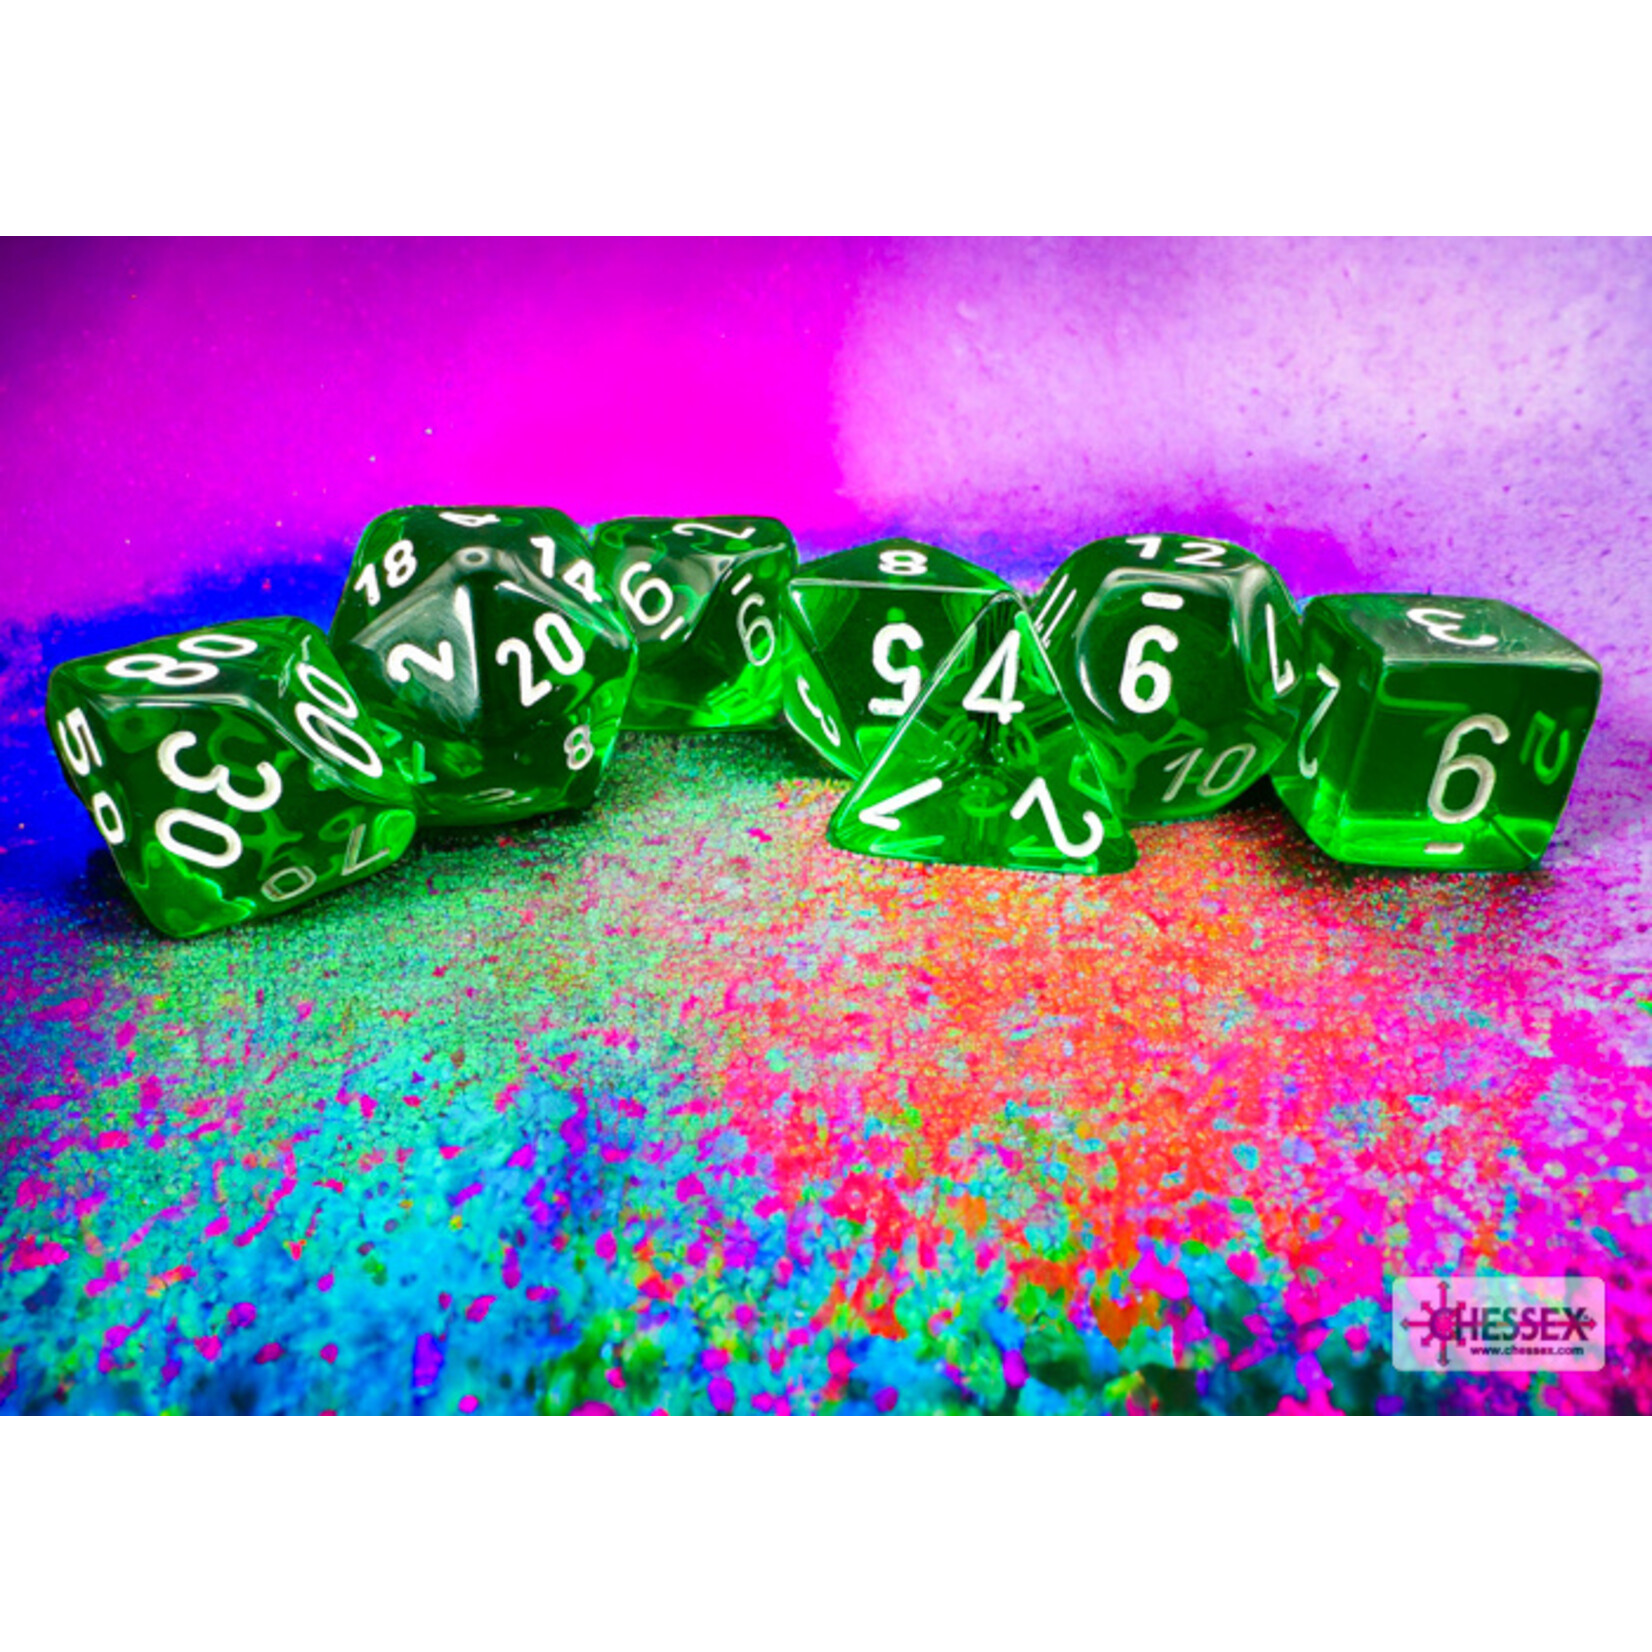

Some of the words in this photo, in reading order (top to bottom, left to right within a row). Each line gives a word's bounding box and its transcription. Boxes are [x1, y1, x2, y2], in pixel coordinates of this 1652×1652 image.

[354, 539, 417, 606] 18
[530, 535, 602, 604] 14
[878, 549, 928, 576] 8
[1125, 536, 1227, 567] 12
[105, 634, 258, 686] 80
[387, 640, 454, 682] 2
[495, 612, 585, 707] 20
[1406, 608, 1498, 647] 3
[962, 629, 1025, 724] 4
[294, 662, 383, 778] 00
[563, 724, 594, 770] 8
[57, 707, 125, 845] 50
[155, 731, 282, 868] 30
[859, 778, 942, 831] 1
[1161, 744, 1256, 802] 10
[1424, 713, 1510, 854] 6
[1010, 777, 1104, 858] 2
